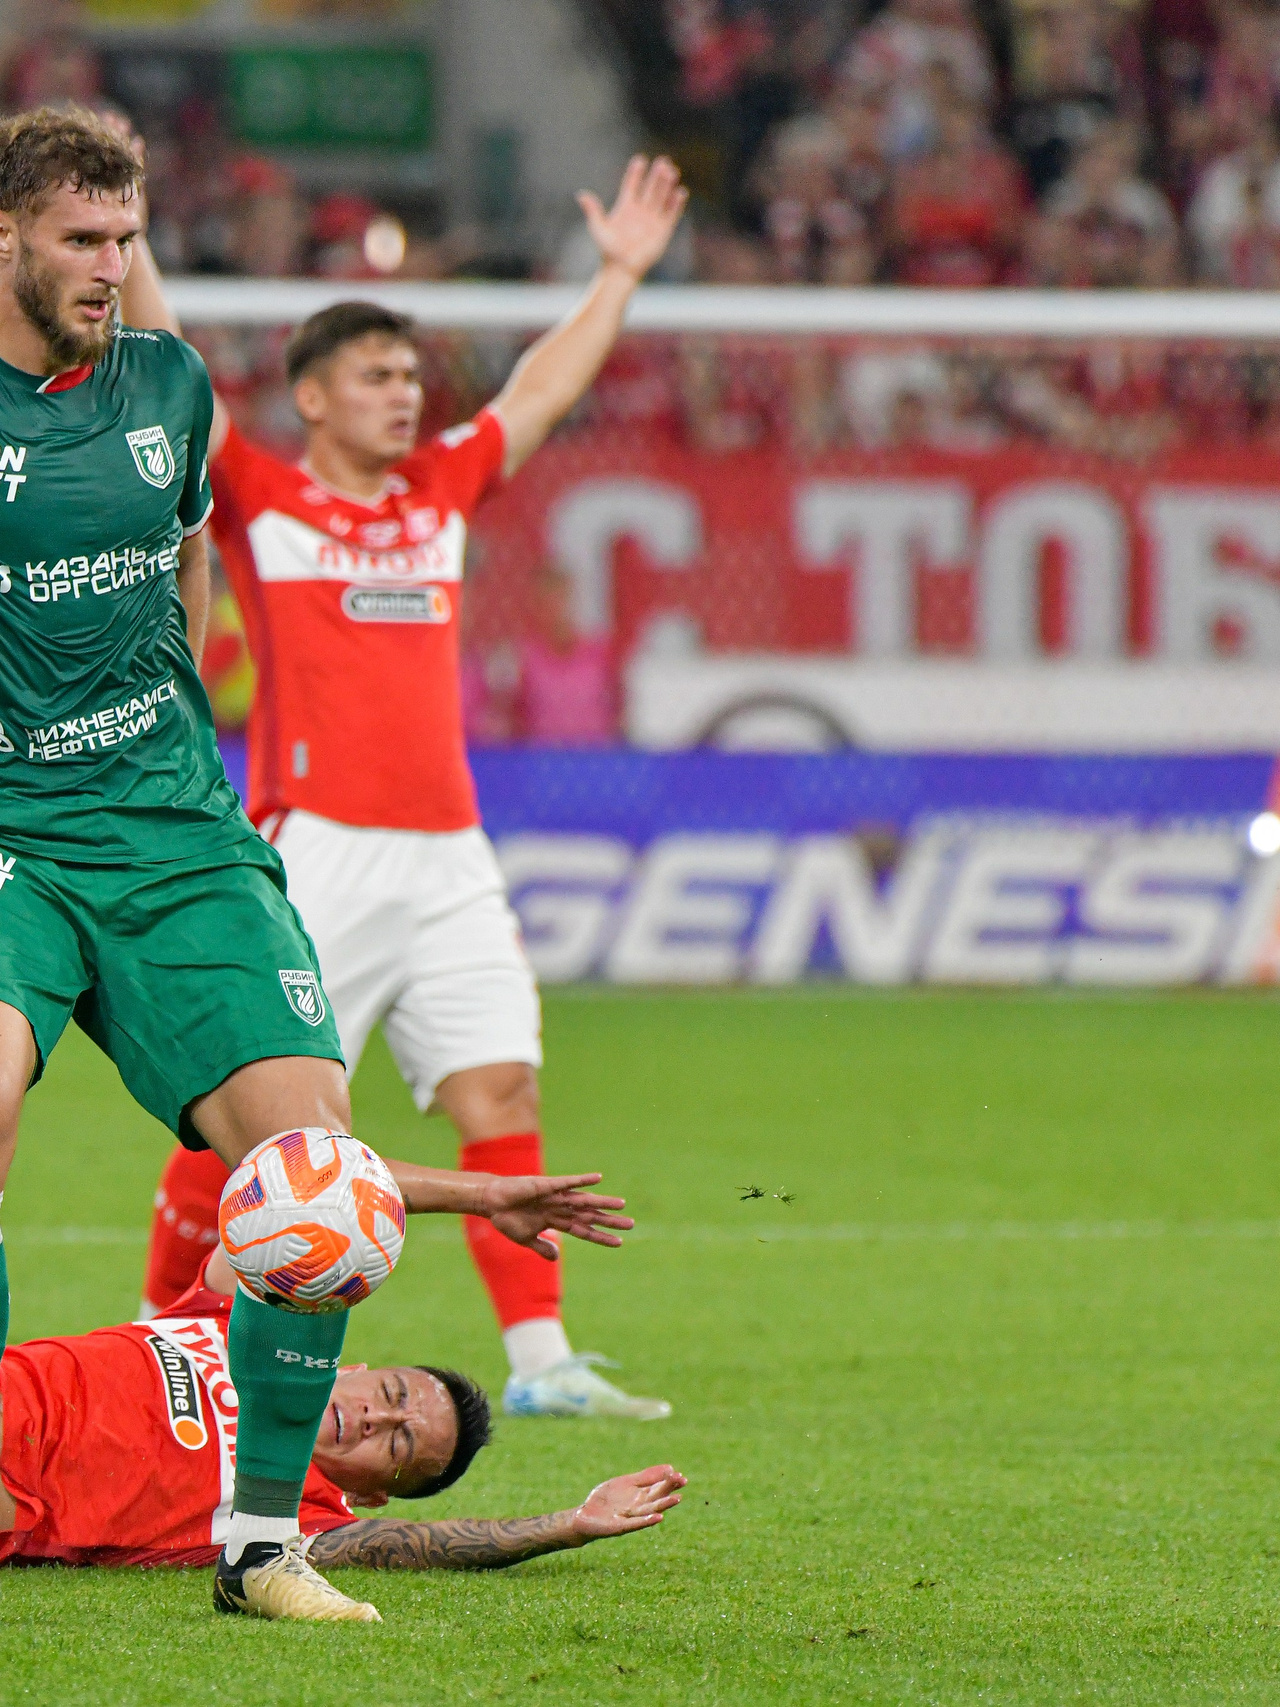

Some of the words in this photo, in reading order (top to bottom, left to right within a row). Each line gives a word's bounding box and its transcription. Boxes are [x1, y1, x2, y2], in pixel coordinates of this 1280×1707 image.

[128, 428, 163, 443] РУБИН
[25, 548, 147, 582] КАЗАНЬ
[25, 680, 178, 744] НИЖНЕКАМСК
[28, 707, 158, 761] НЕФТЕХИМ
[281, 972, 315, 982] РУБИН
